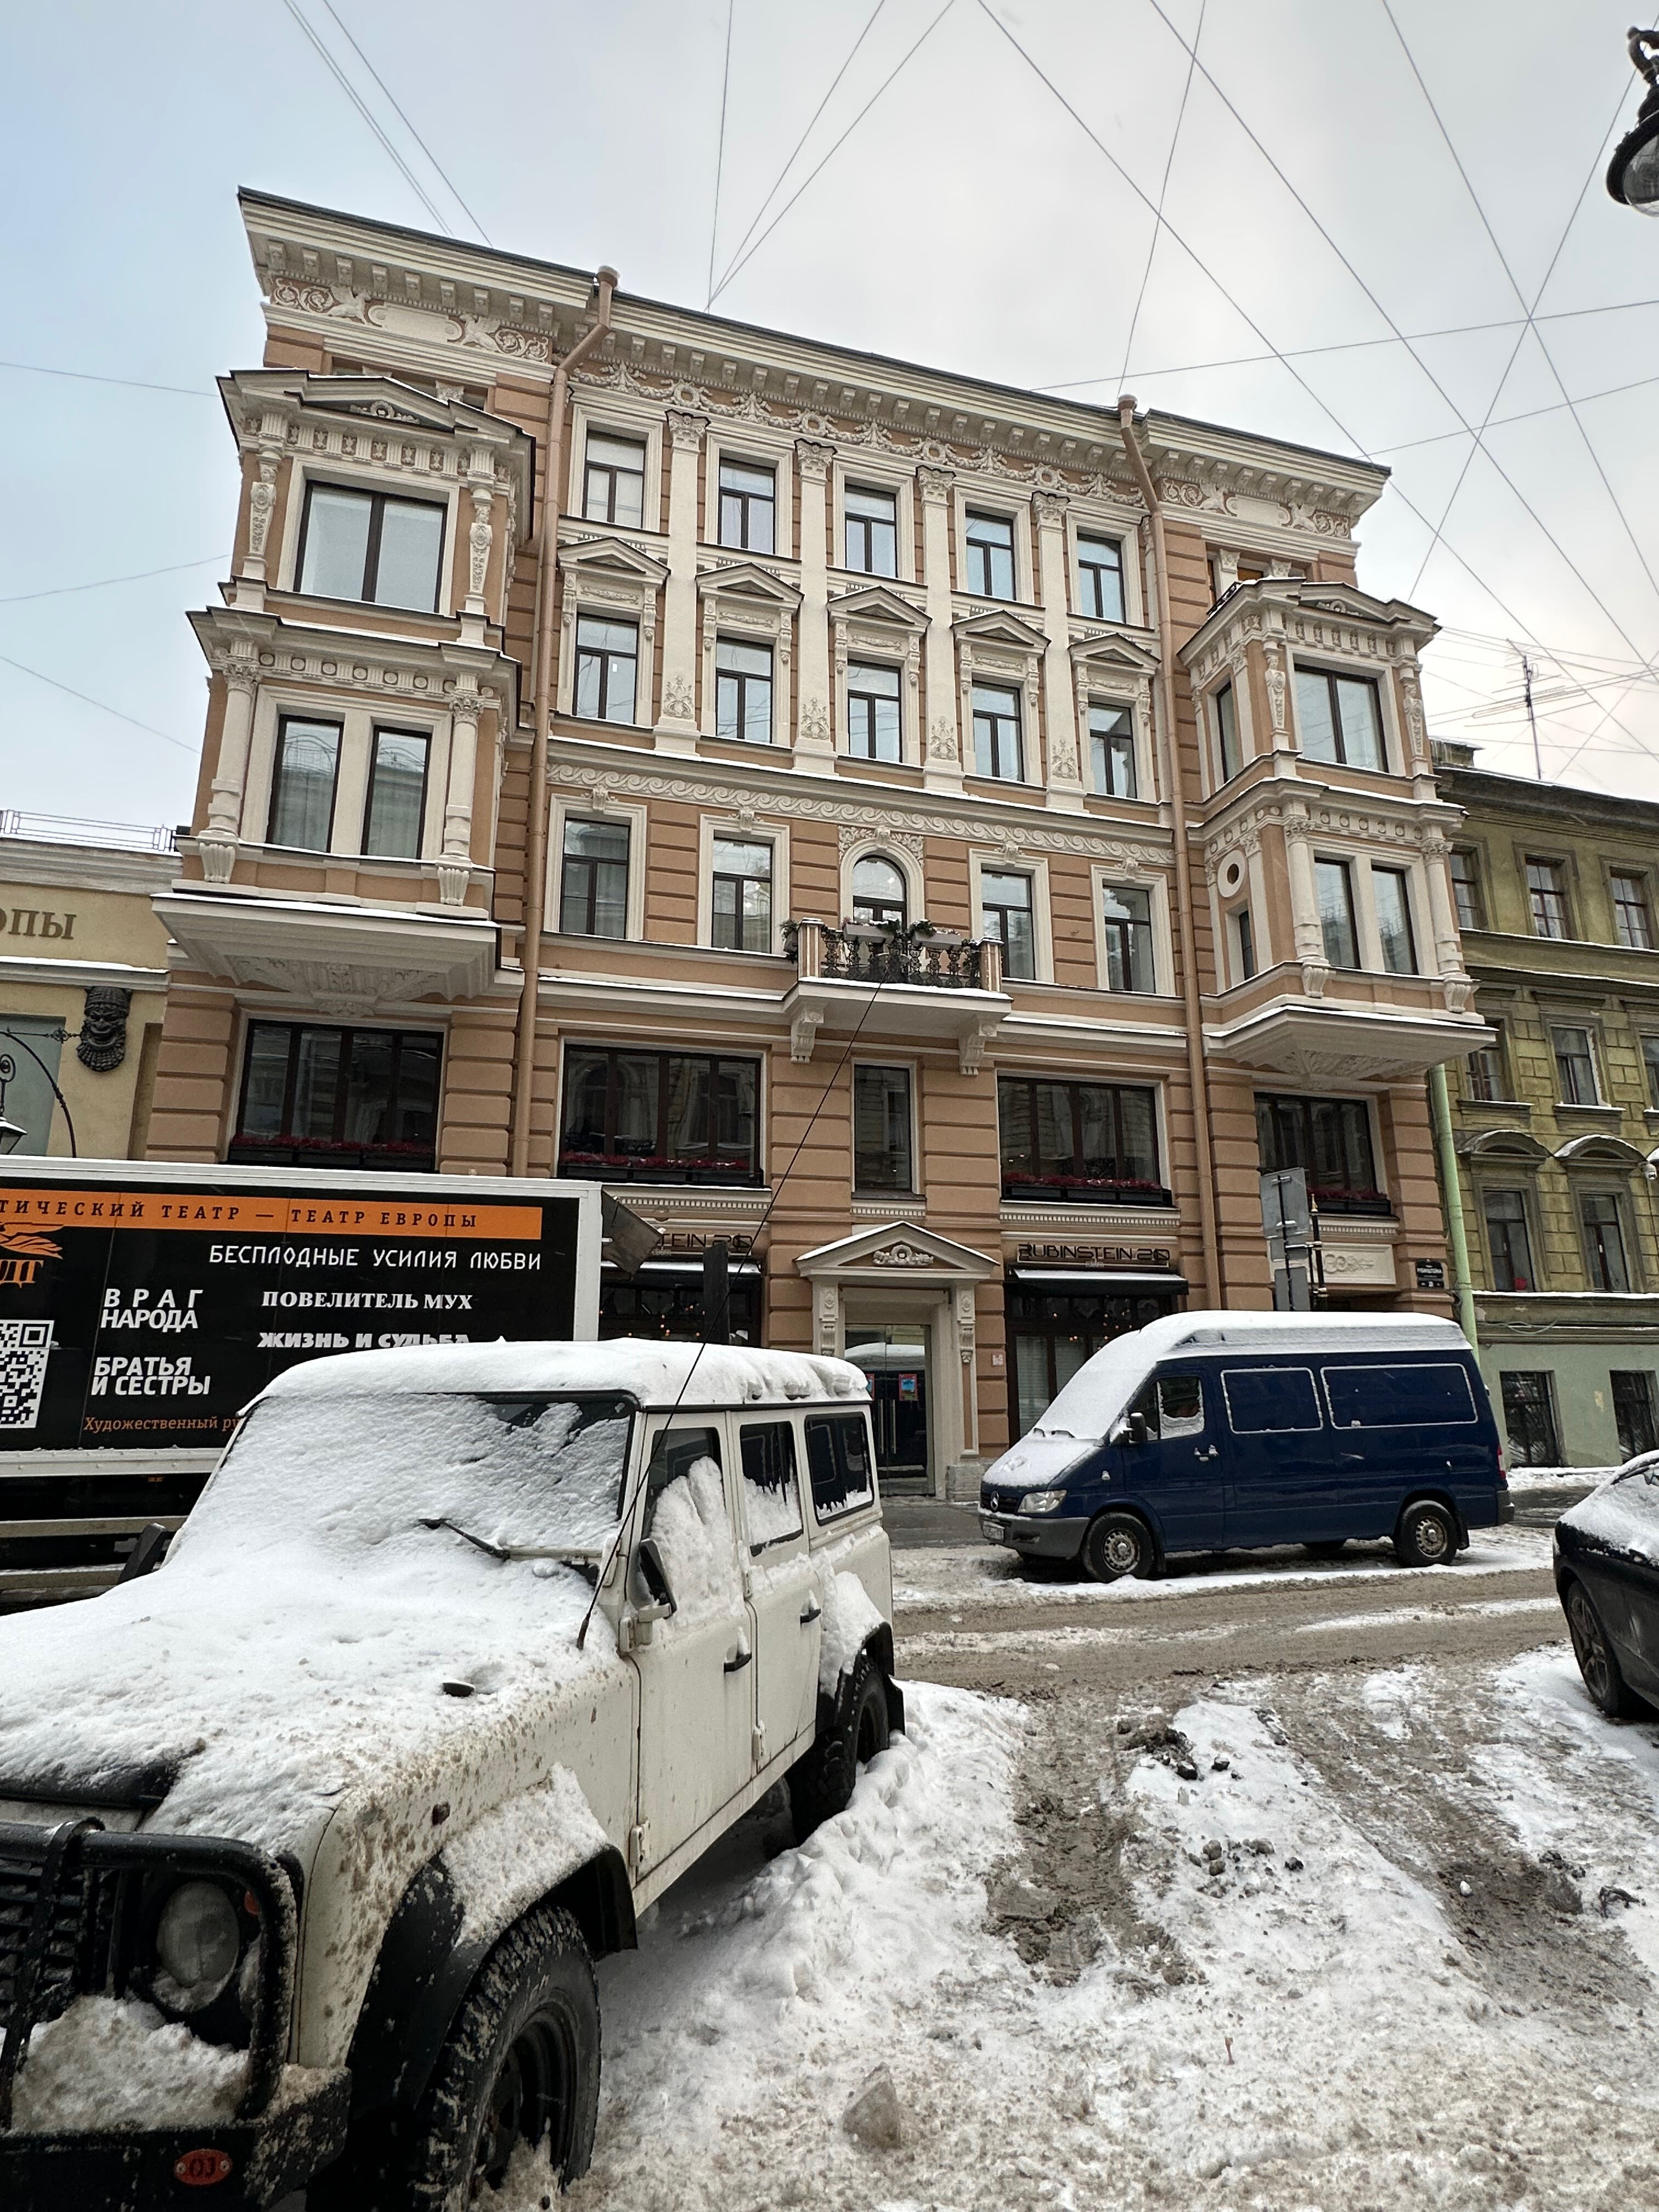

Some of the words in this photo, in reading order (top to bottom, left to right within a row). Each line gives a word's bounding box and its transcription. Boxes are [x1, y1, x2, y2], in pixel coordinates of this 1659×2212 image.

[162, 1205, 239, 1220] ТЕАТР
[291, 1209, 365, 1224] ТЕАТР
[380, 1212, 477, 1227] ЕВРОПЫ
[209, 1245, 359, 1268] БЕСПЛОДНЫЕ
[373, 1249, 457, 1268] УСИЛИЯ
[470, 1252, 541, 1270] ЛЮБВИ
[1018, 1243, 1132, 1260] RUBINSTEIN
[104, 1288, 203, 1308] ВРАГ
[261, 1291, 419, 1309] ПОВЕЛИТЕЛЬ
[424, 1294, 473, 1310] МУХ
[100, 1310, 198, 1333] НАРОДА
[257, 1332, 349, 1348] ЖИЗНЬ
[355, 1333, 373, 1348] И
[94, 1357, 192, 1376] БРАТЬЯ
[91, 1376, 107, 1396] И
[115, 1376, 211, 1396] СЕСТРЫ
[83, 1416, 218, 1434] Художественный
